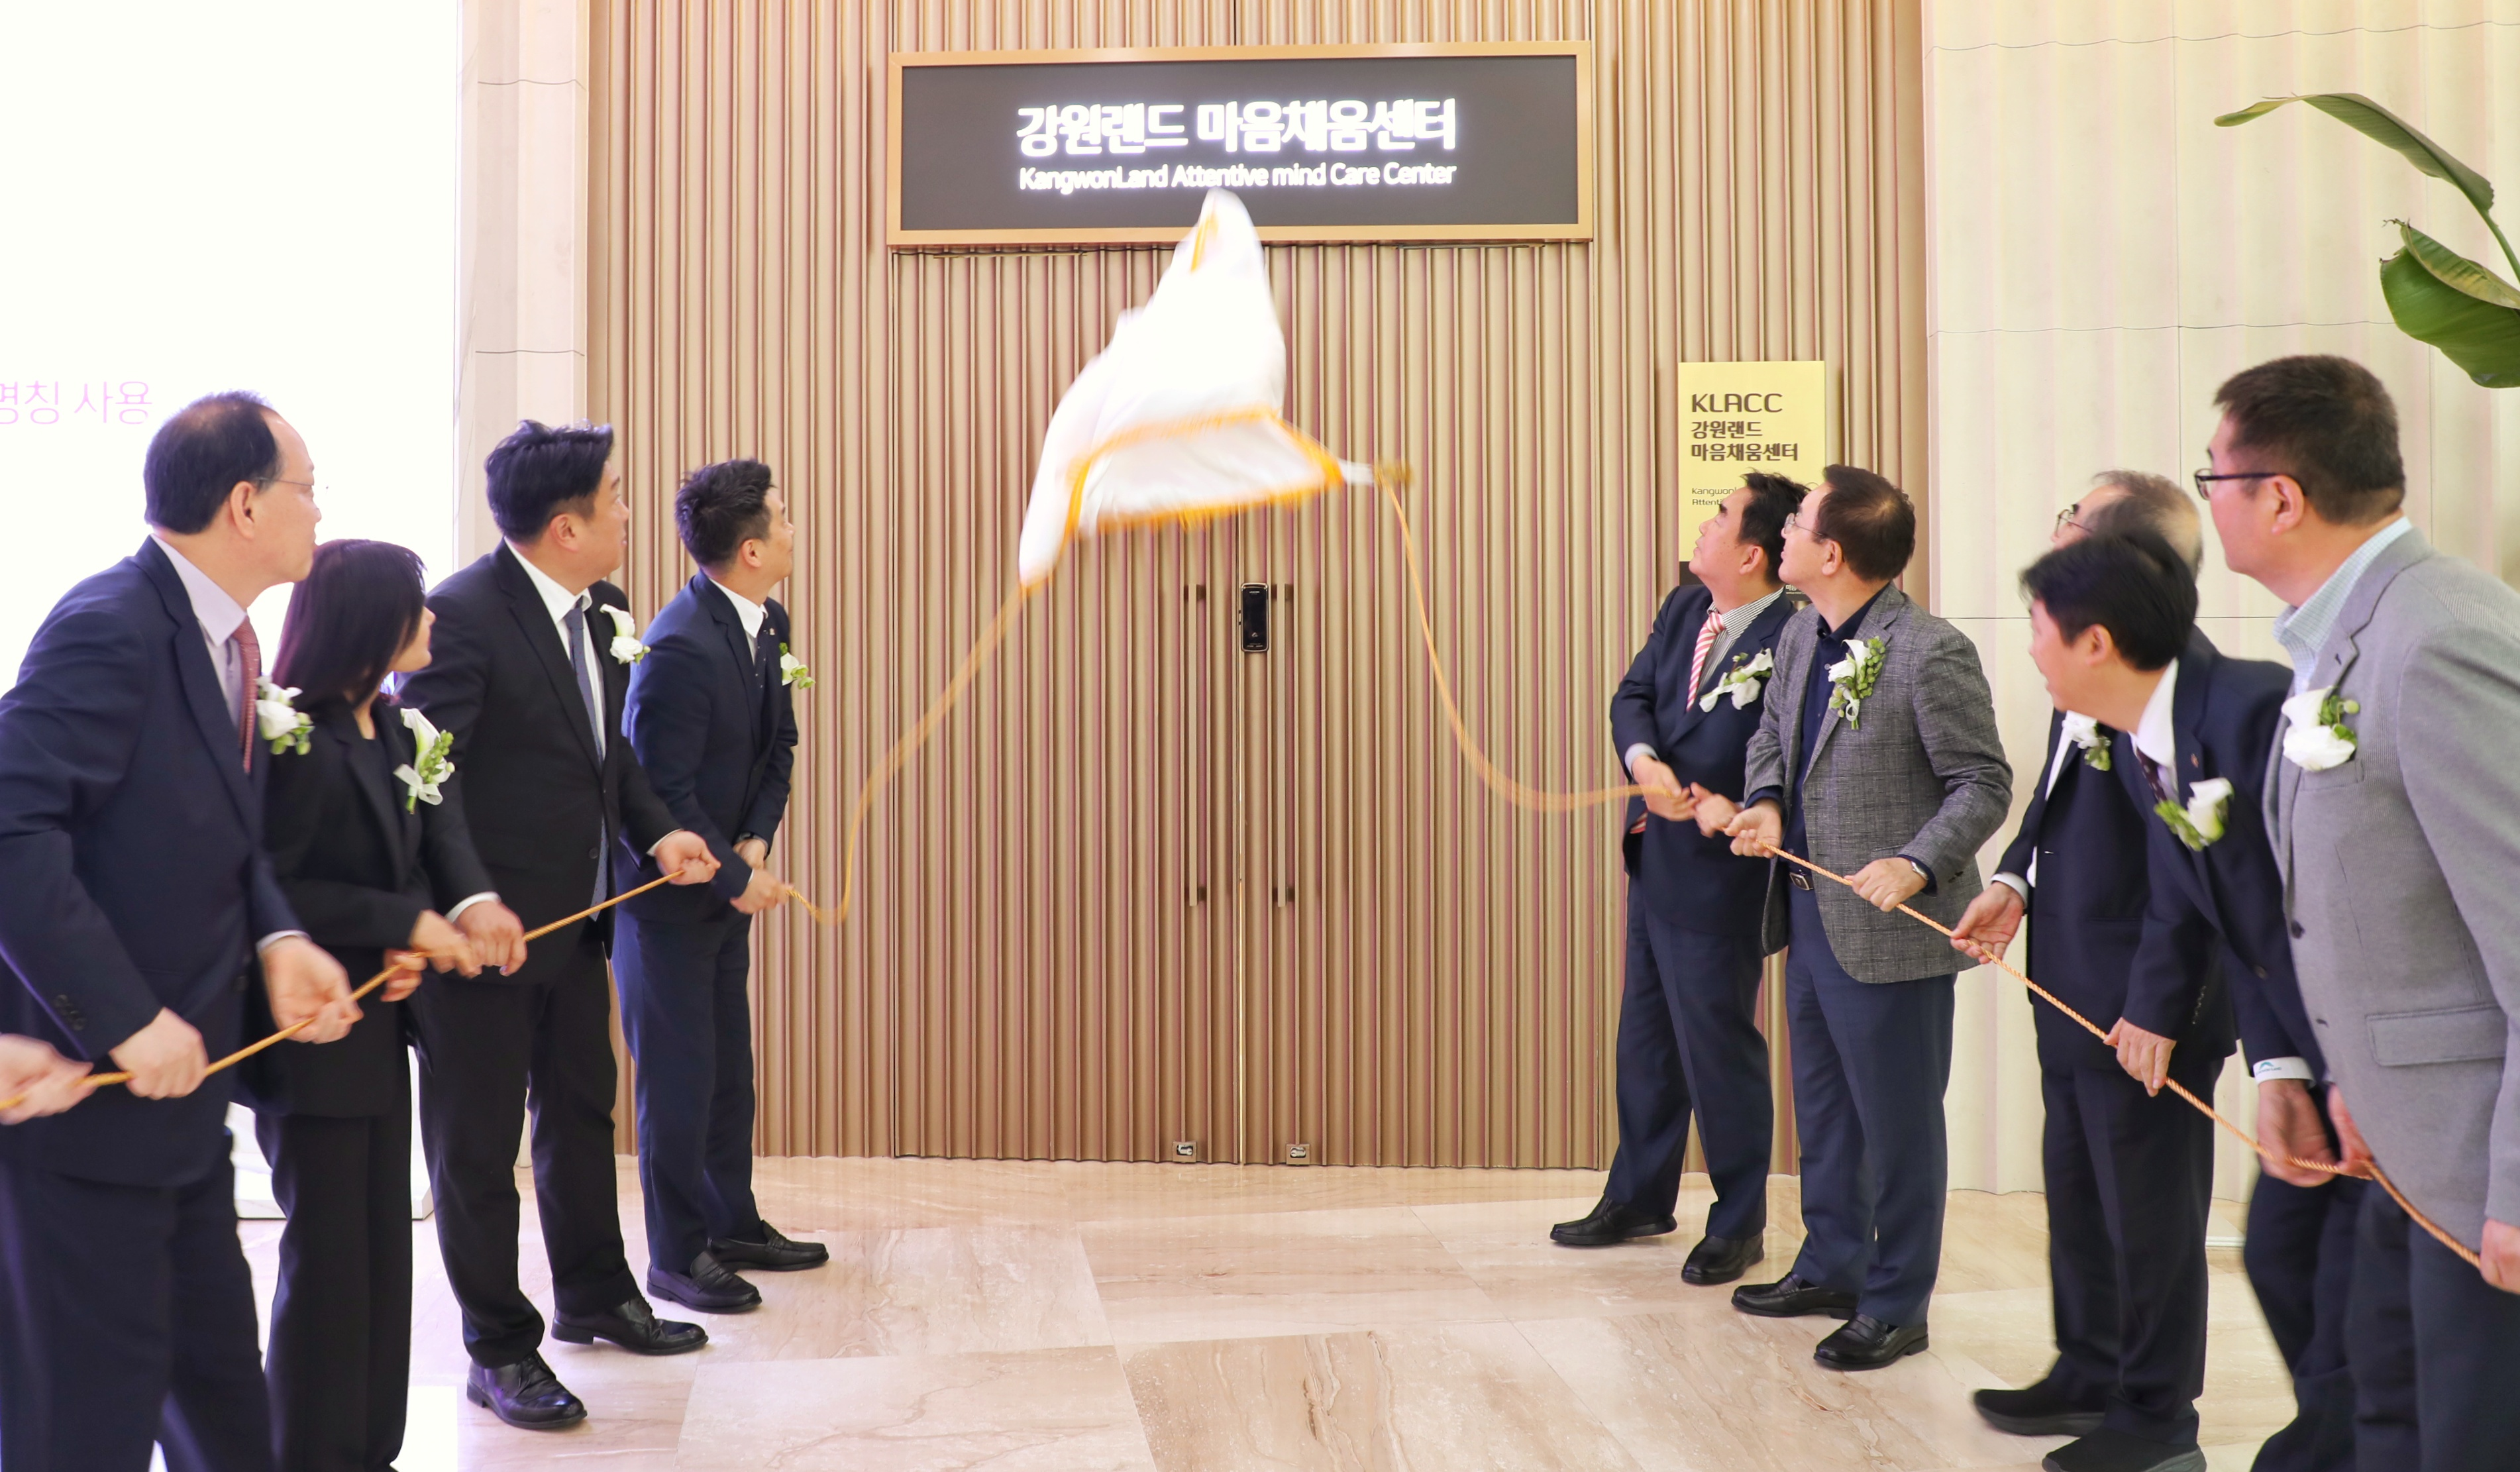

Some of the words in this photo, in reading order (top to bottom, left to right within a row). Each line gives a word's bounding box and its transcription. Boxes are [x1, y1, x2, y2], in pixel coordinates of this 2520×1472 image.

[1016, 102, 1189, 158] 강원랜드
[1197, 98, 1457, 153] 마음채움센터
[1020, 164, 1169, 195] KangwonLand
[1171, 163, 1270, 188] Attentive
[1272, 162, 1327, 187] mind
[1330, 162, 1381, 186] Care
[1383, 162, 1457, 185] Center
[74, 381, 153, 425] 사용
[1691, 393, 1783, 413] KLACC
[1691, 420, 1763, 440] 강원랜드
[1691, 443, 1799, 462] 마음채움센터
[1691, 487, 1737, 497] Kangwon
